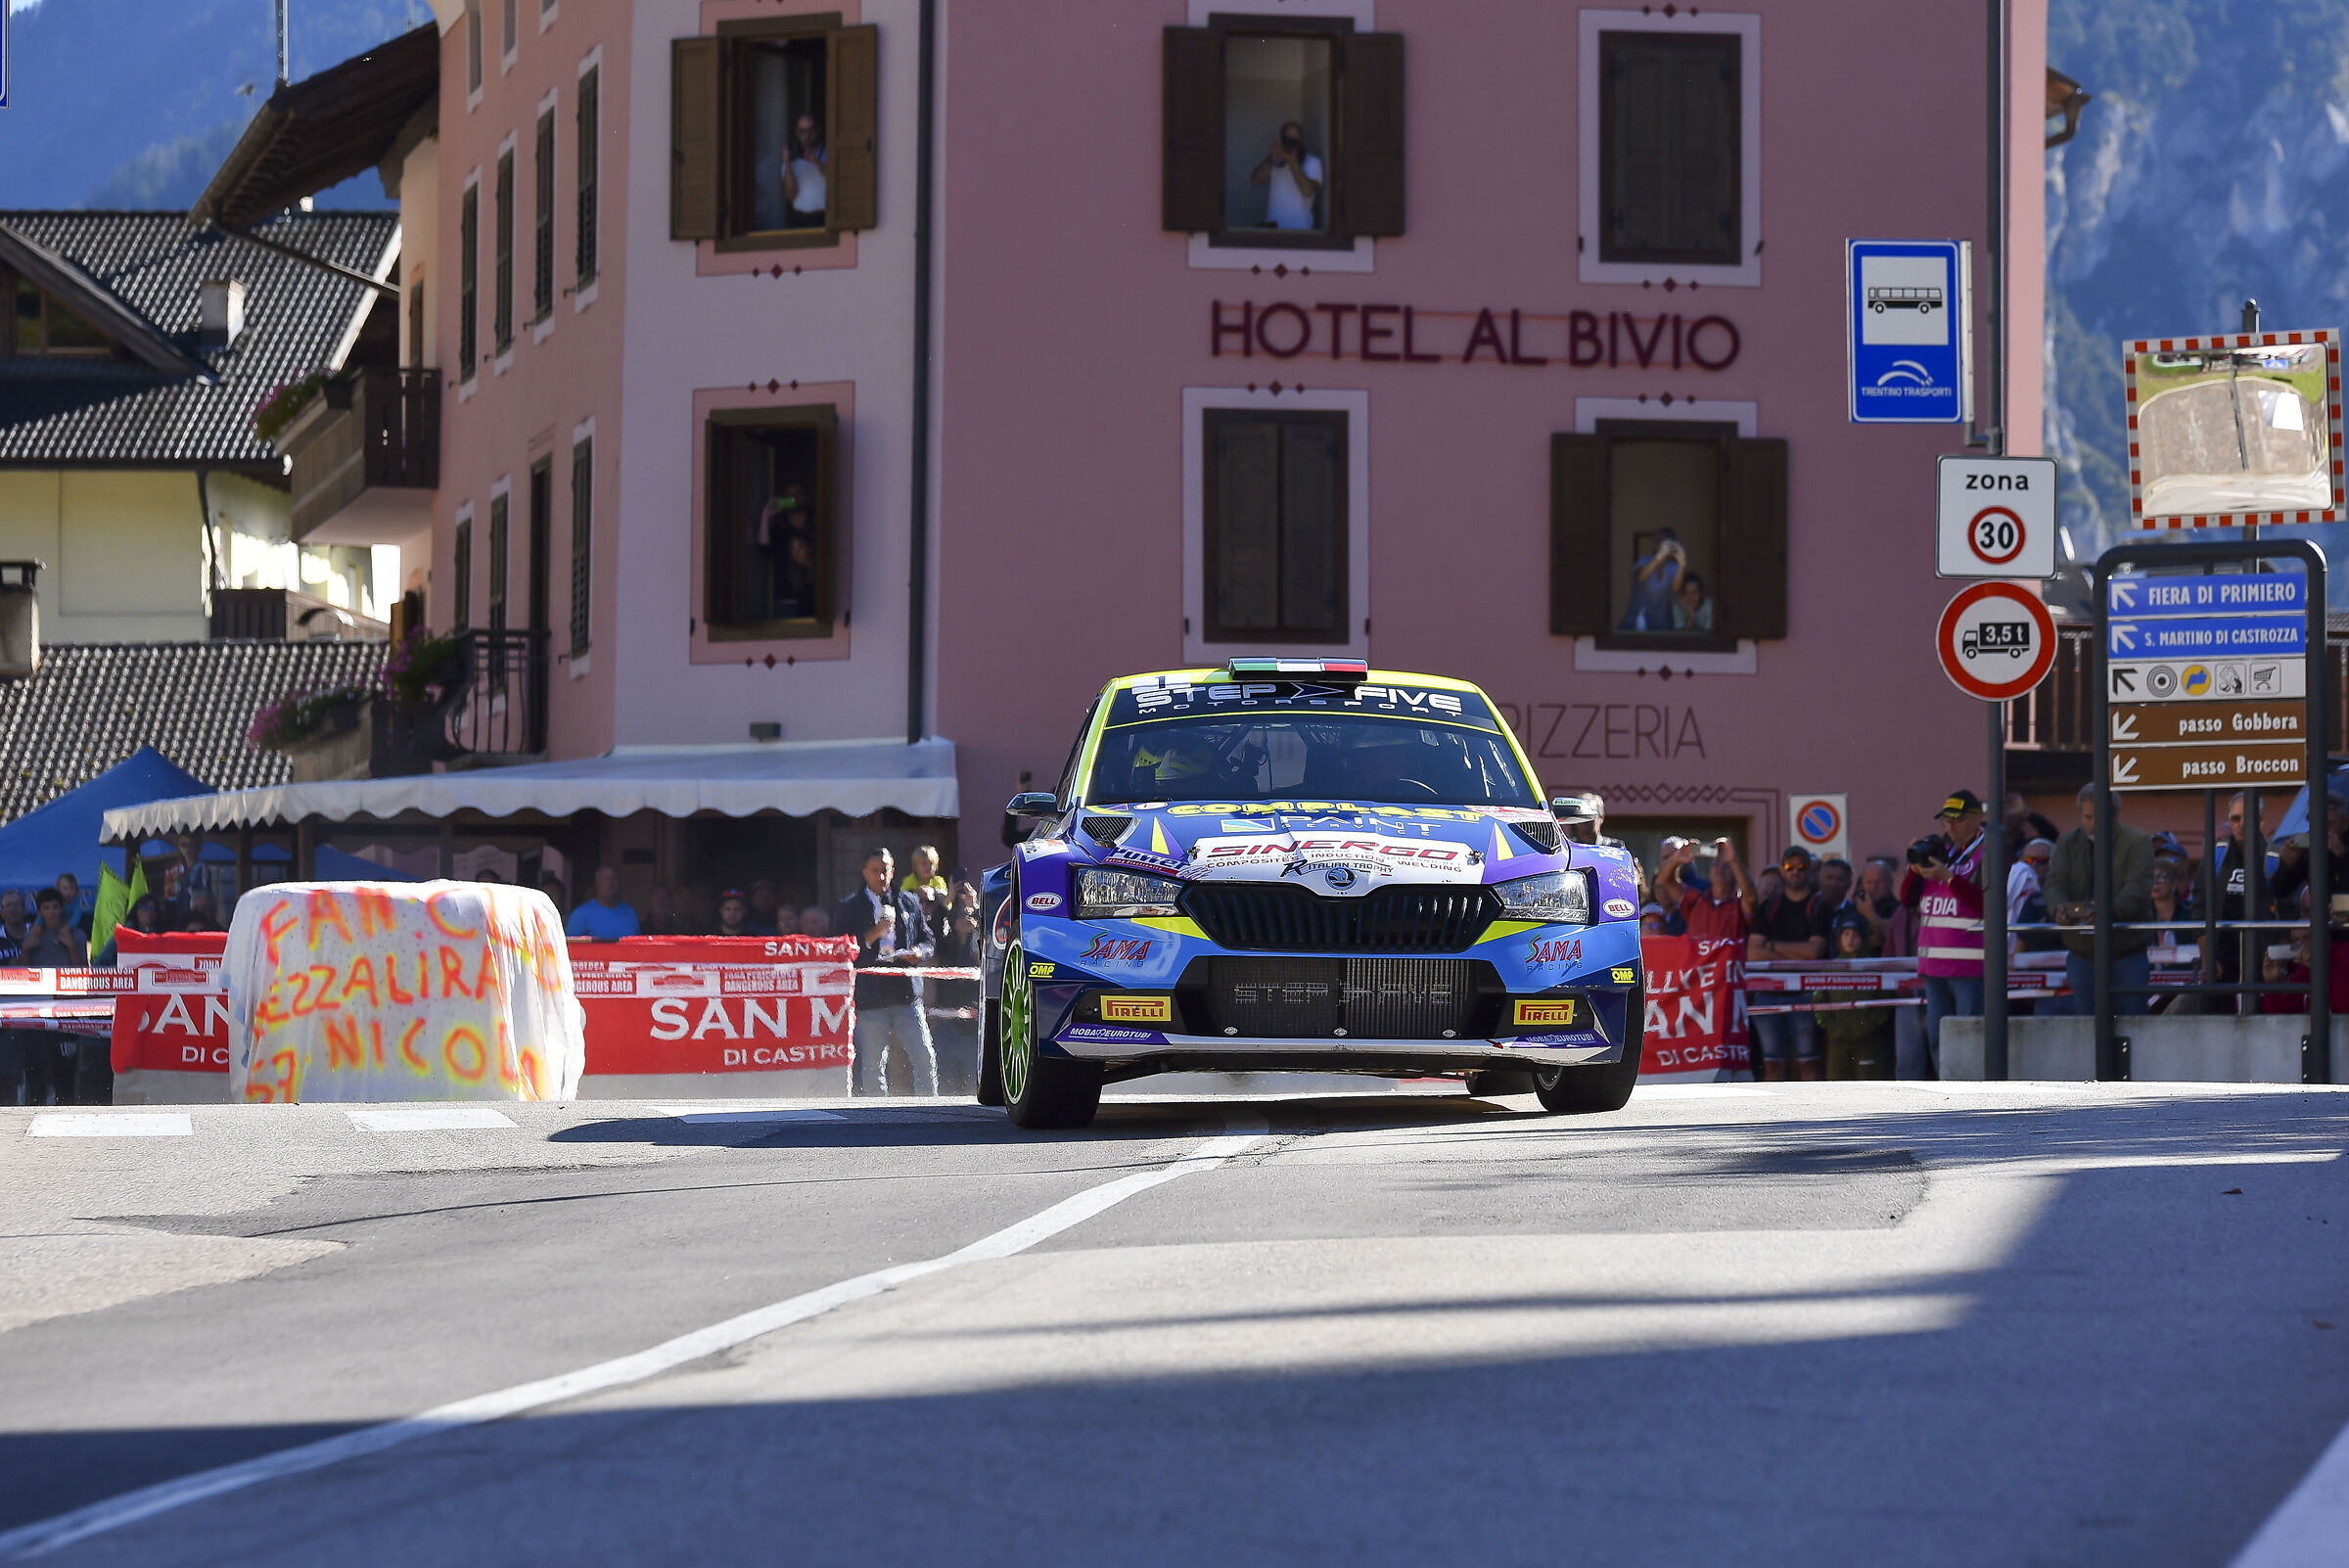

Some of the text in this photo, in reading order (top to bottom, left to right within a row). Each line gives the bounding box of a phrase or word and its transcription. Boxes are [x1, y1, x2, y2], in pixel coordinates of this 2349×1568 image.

[1212, 300, 1741, 371] HOTEL AL BIVIO
[1862, 387, 1953, 397] TRENTINO TRASPORTI
[1965, 474, 2029, 490] zona
[1979, 522, 2014, 549] 30
[2148, 582, 2296, 606] FIERA DI PRIMIERO
[2144, 627, 2298, 647] S. MARTINO DI CASTROZZA
[1135, 683, 1462, 712] STEP FIVE
[1138, 698, 1462, 716] MOTORSPORT
[2179, 712, 2298, 736] passo Gobbera
[2182, 755, 2299, 779] passo Broccon
[1280, 815, 1442, 831] PAINT
[1207, 841, 1458, 860] SINERGO
[1207, 855, 1300, 869] COMPOSITES
[1311, 853, 1385, 862] INDUCTION
[1398, 860, 1462, 872] WELDING
[1031, 897, 1056, 905] BELL
[1608, 902, 1632, 912] BELL
[764, 941, 809, 956] SAN
[1081, 930, 1152, 961] SAMA
[1525, 933, 1583, 963] SAMA
[1029, 963, 1055, 976] OMP
[1080, 959, 1144, 968] RACING
[1527, 961, 1583, 972] RACING
[60, 976, 134, 990] DANGEROUS AREA
[1611, 970, 1634, 982] OMP
[611, 980, 633, 992] AREA
[137, 992, 229, 1037] AN
[1106, 999, 1165, 1018] PIRELLI
[1520, 1003, 1570, 1022] PIRELLI
[650, 996, 788, 1041] SAN
[1104, 1030, 1152, 1038] EUROTUBI
[1554, 1033, 1594, 1041] EUROTUBI
[182, 1045, 205, 1062] DI
[723, 1048, 747, 1065] DI
[1658, 1048, 1681, 1066] DI
